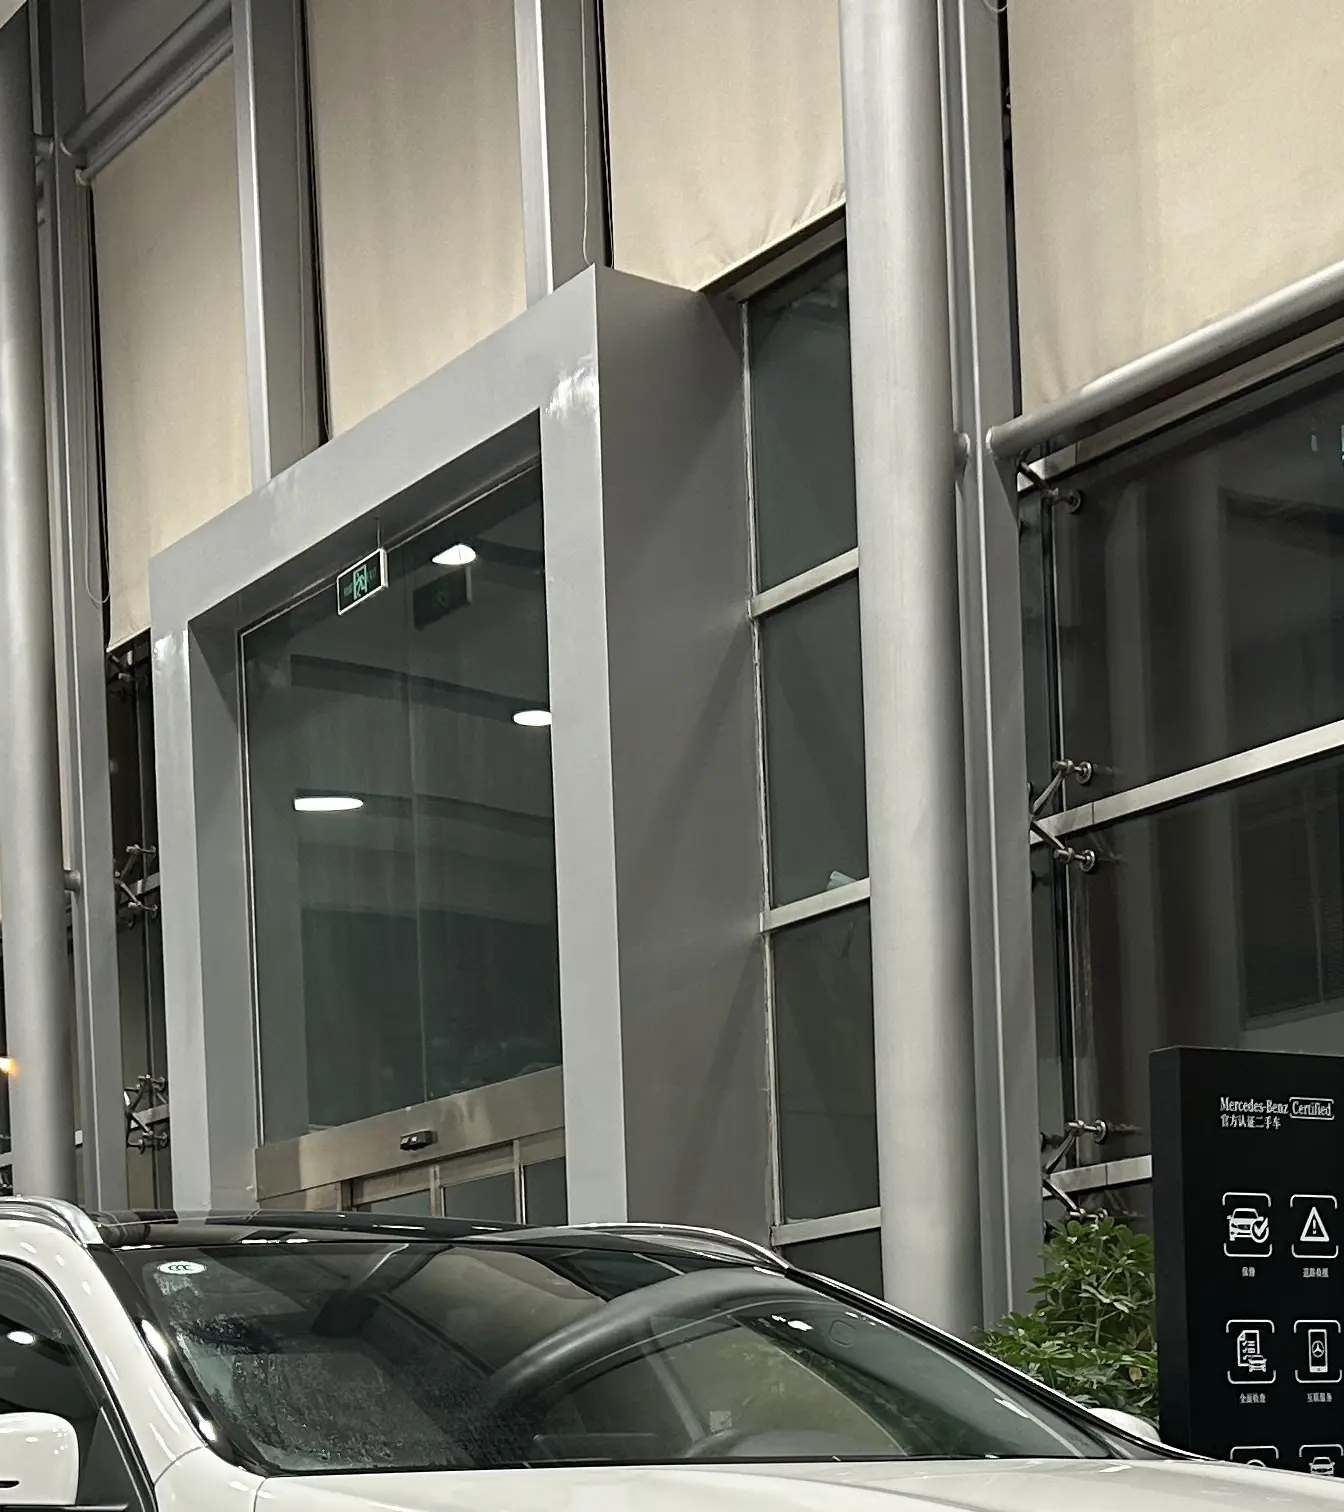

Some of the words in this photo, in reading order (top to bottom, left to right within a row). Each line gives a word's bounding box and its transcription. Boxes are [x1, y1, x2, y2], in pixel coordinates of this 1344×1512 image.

[1220, 1096, 1289, 1114] Mercedes-Benz
[1292, 1100, 1332, 1117] Certified
[1220, 1113, 1282, 1130] 官方认证二手车
